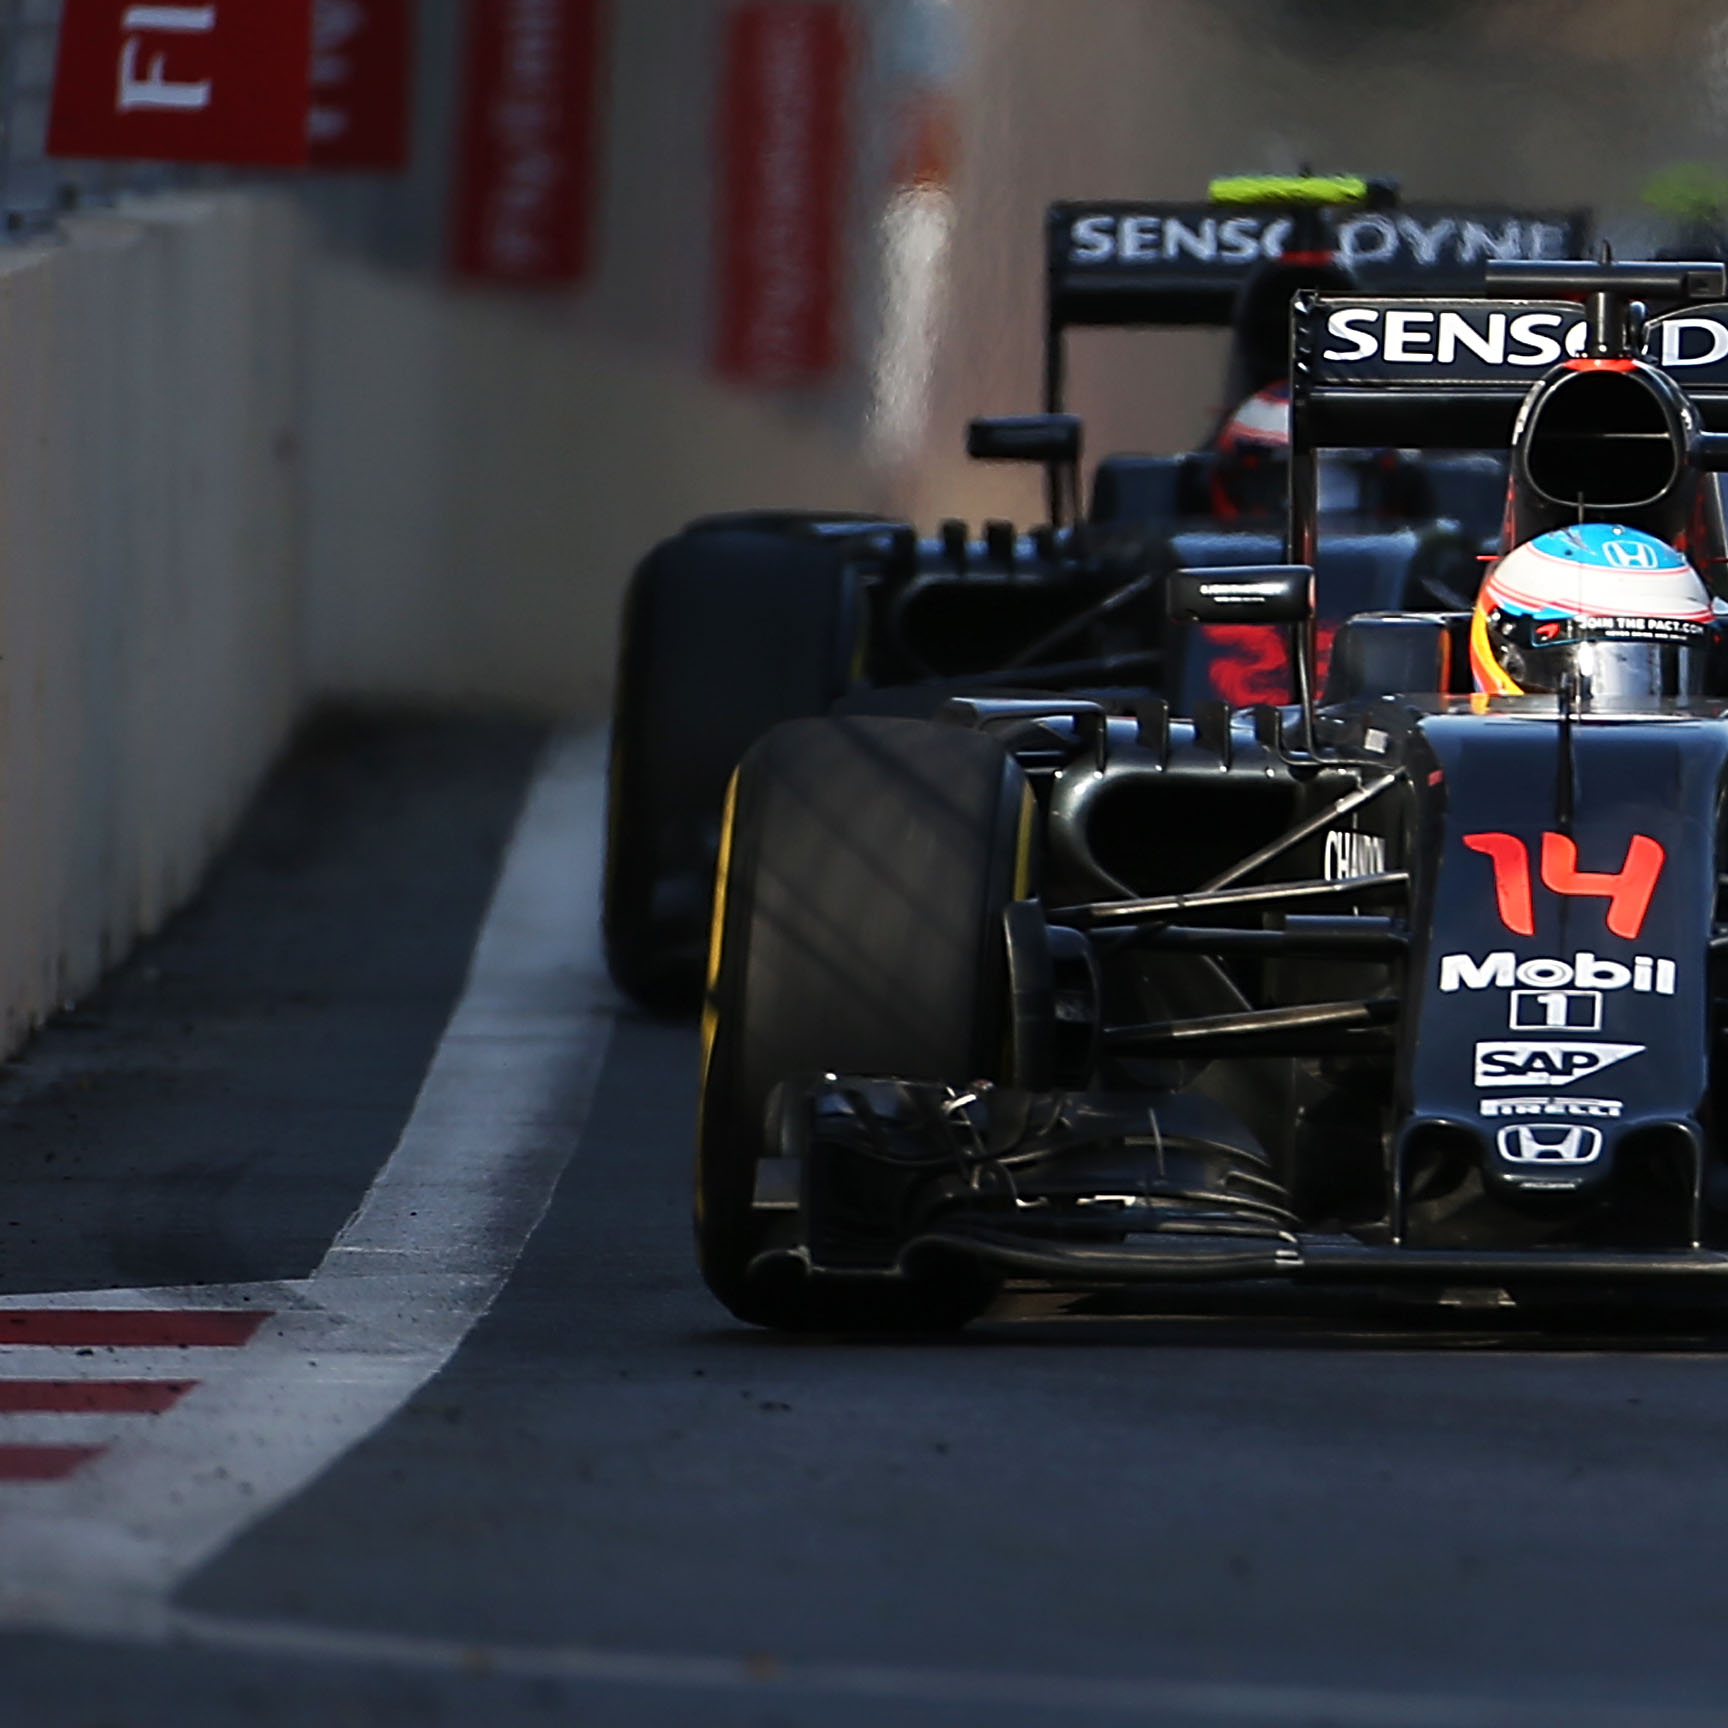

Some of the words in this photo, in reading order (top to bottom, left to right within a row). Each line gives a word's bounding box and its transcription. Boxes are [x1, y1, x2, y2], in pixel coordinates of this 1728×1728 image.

[1463, 831, 1665, 940] 14
[1440, 952, 1676, 995] Mobil
[1480, 1049, 1600, 1077] SAP
[1480, 1096, 1624, 1117] PIRELLI
